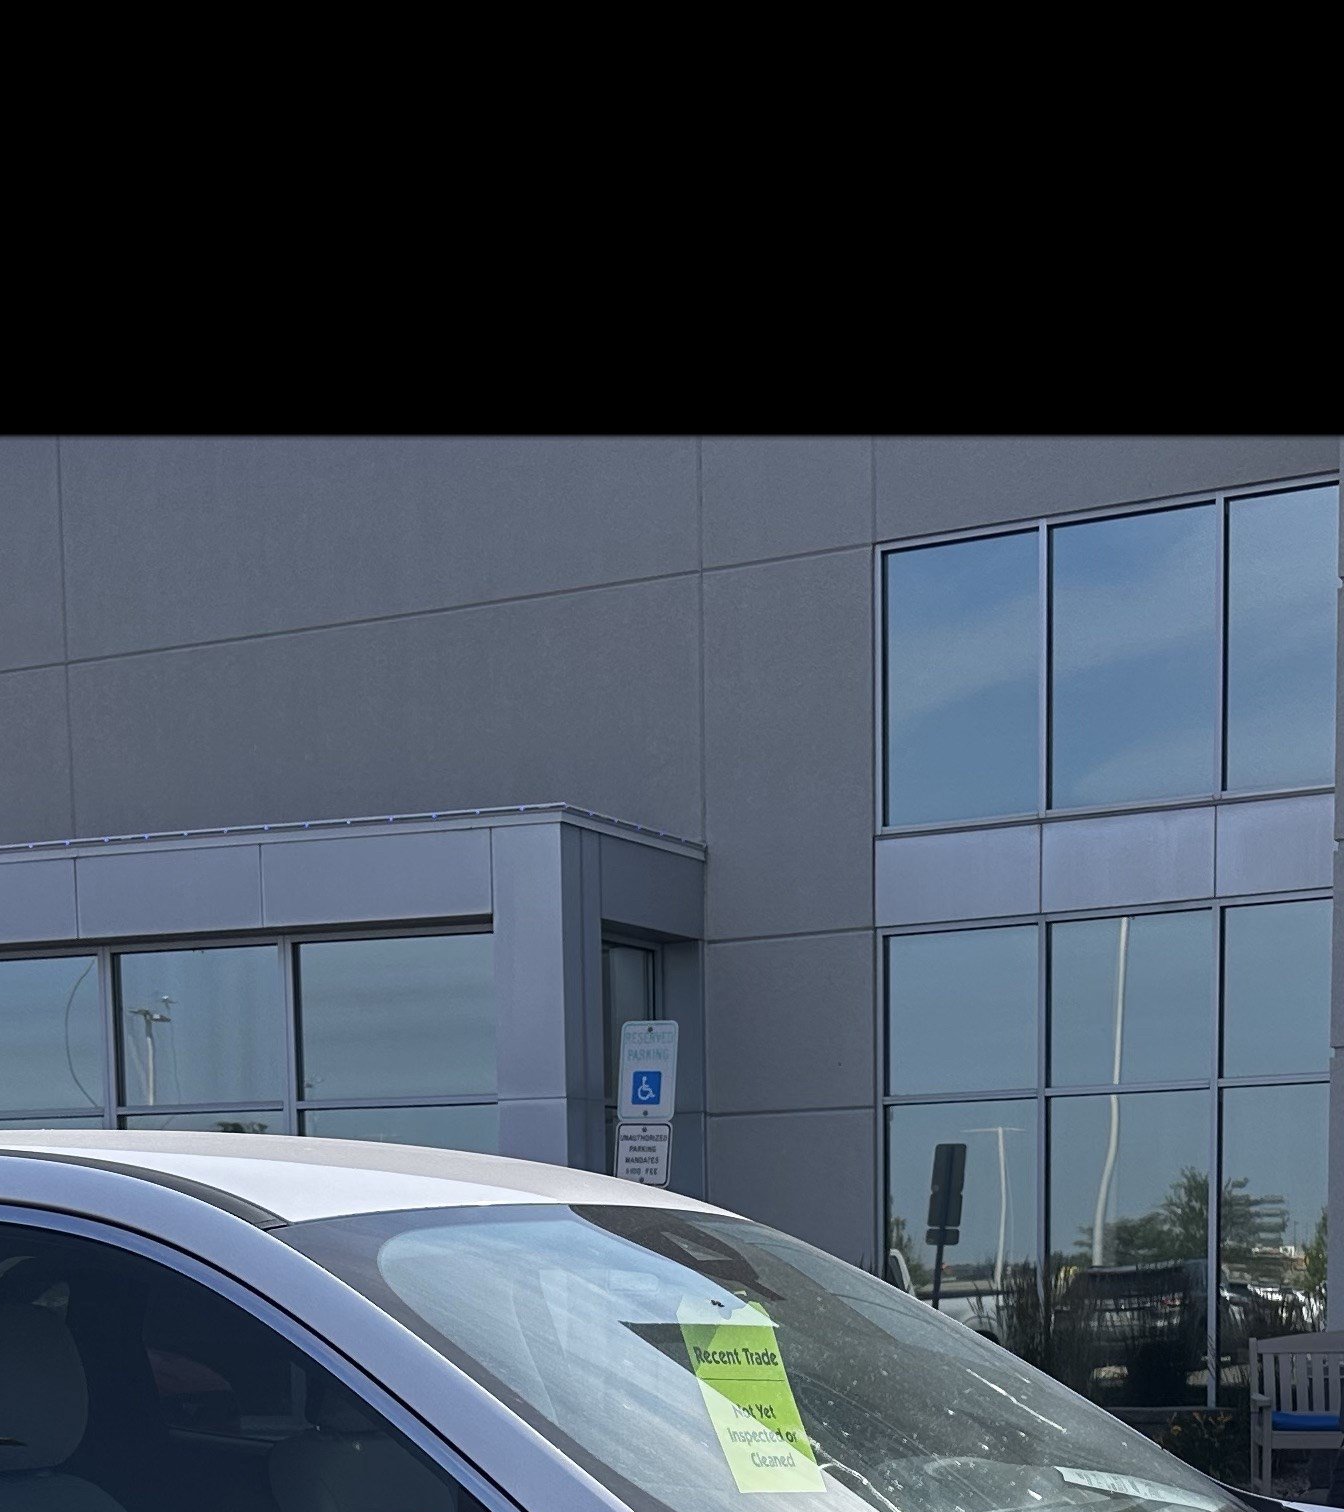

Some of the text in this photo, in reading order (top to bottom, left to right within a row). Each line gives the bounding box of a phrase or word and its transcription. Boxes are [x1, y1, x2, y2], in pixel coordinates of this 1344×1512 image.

[693, 1347, 779, 1367] Recent Trade
[733, 1403, 777, 1420] Not Yet
[727, 1427, 799, 1445] Inspected or
[750, 1452, 796, 1468] Cleaned
